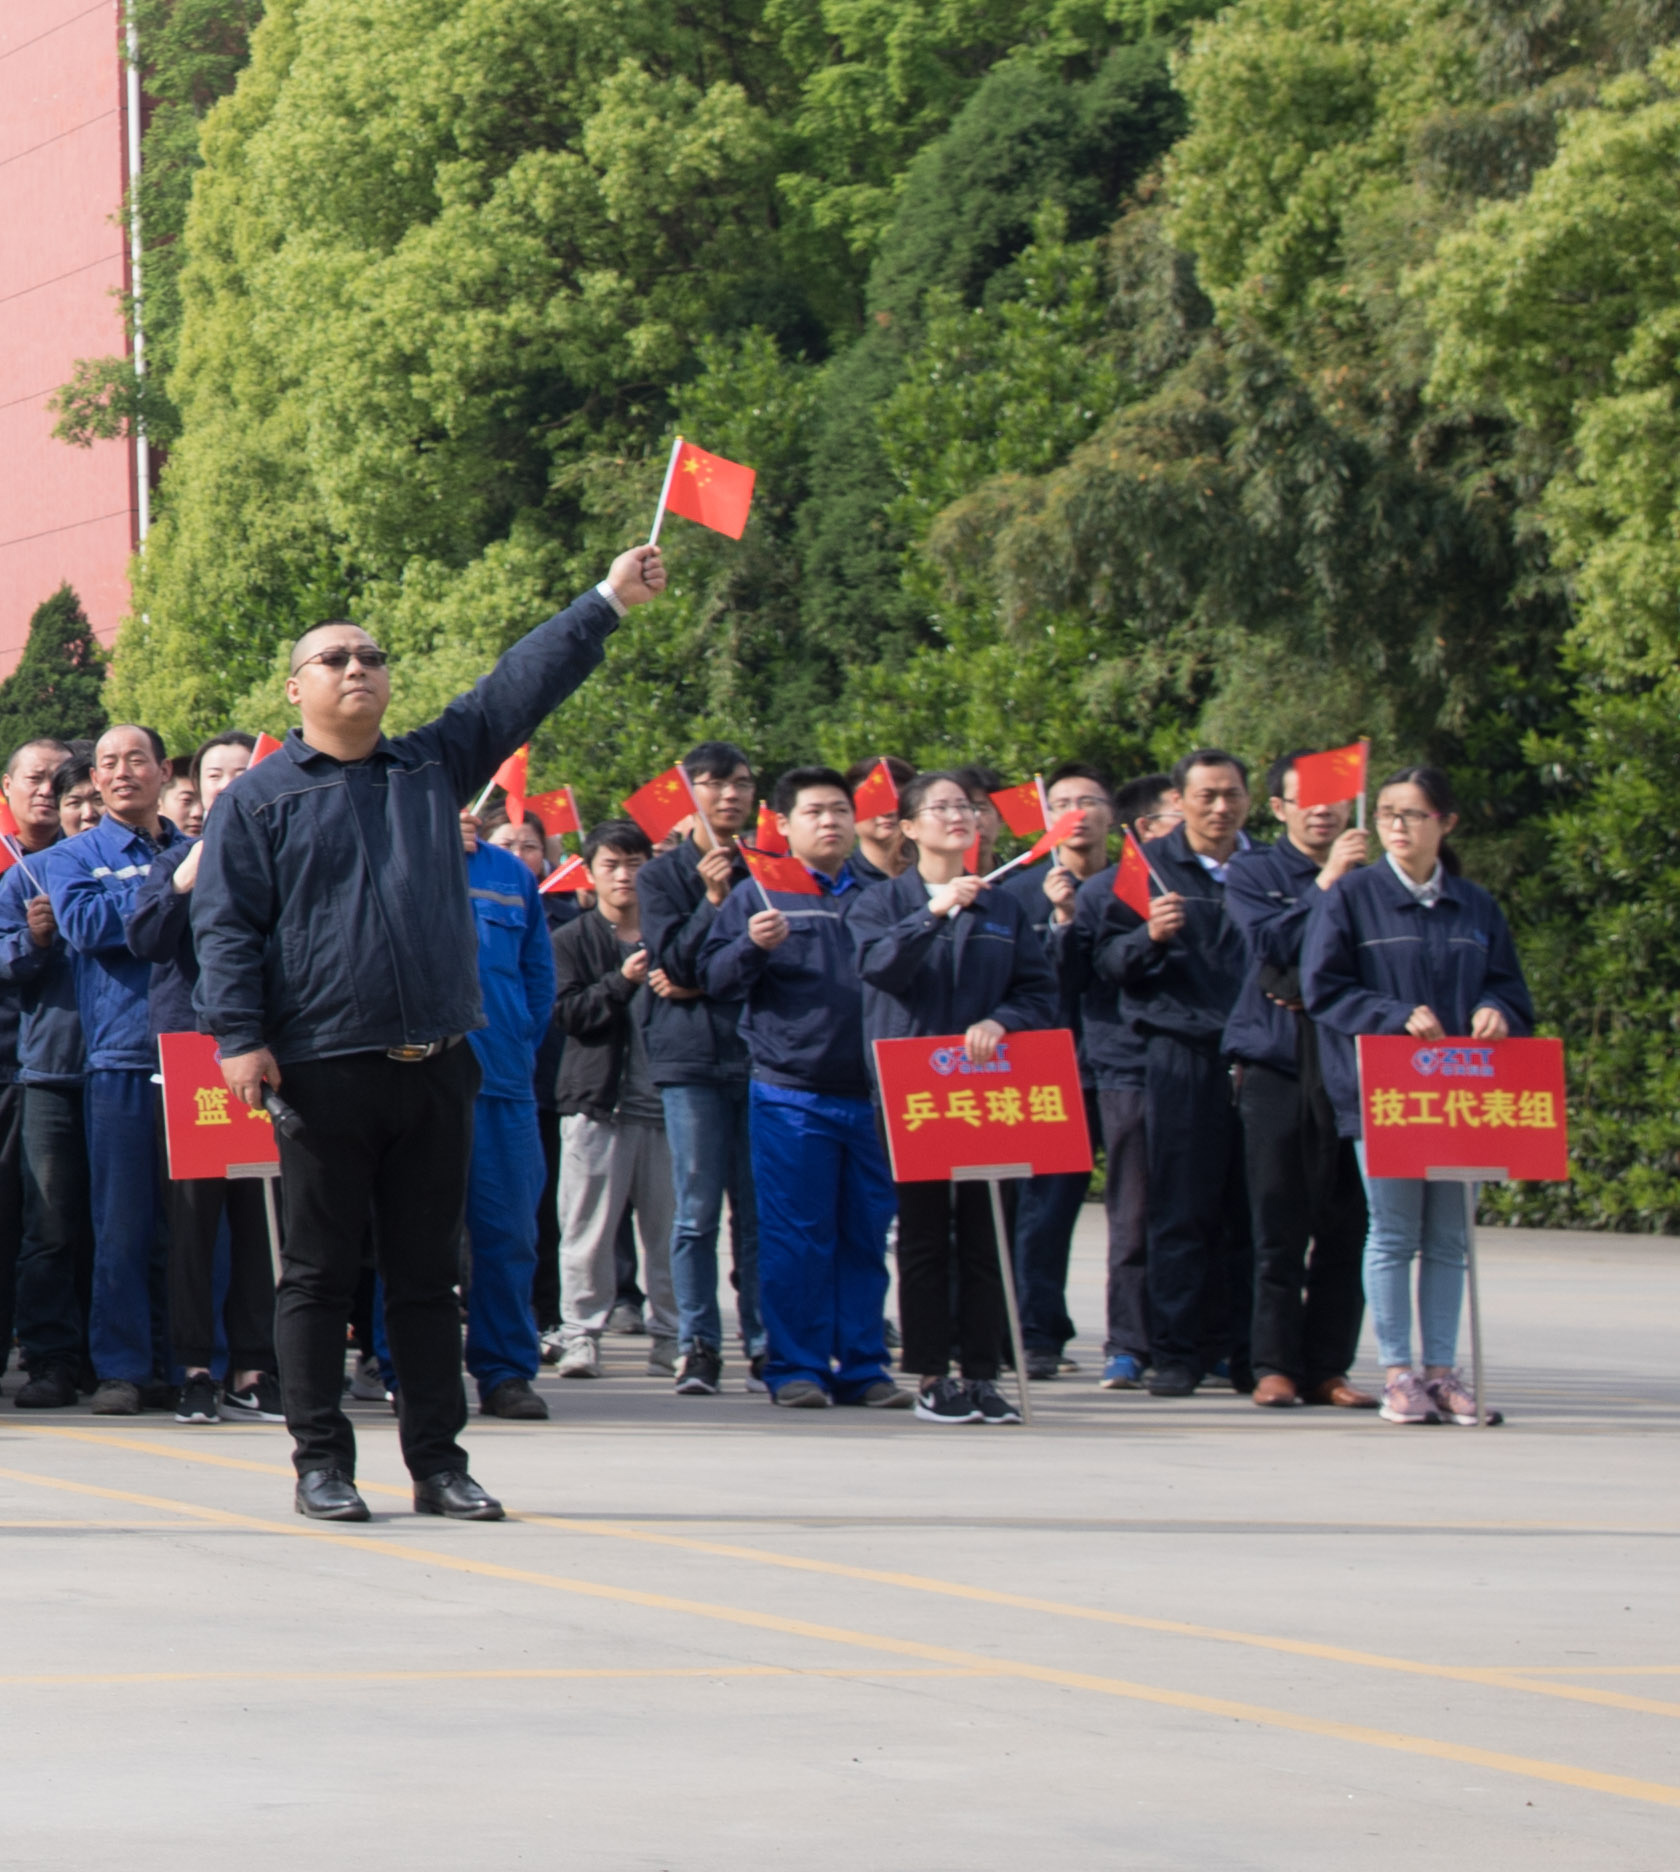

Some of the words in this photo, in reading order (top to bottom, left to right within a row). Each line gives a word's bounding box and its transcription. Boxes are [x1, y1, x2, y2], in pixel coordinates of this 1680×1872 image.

[1441, 1048, 1494, 1064] ZTT
[902, 1085, 1069, 1132] 乒乓球组
[1369, 1087, 1557, 1128] 技工代表组
